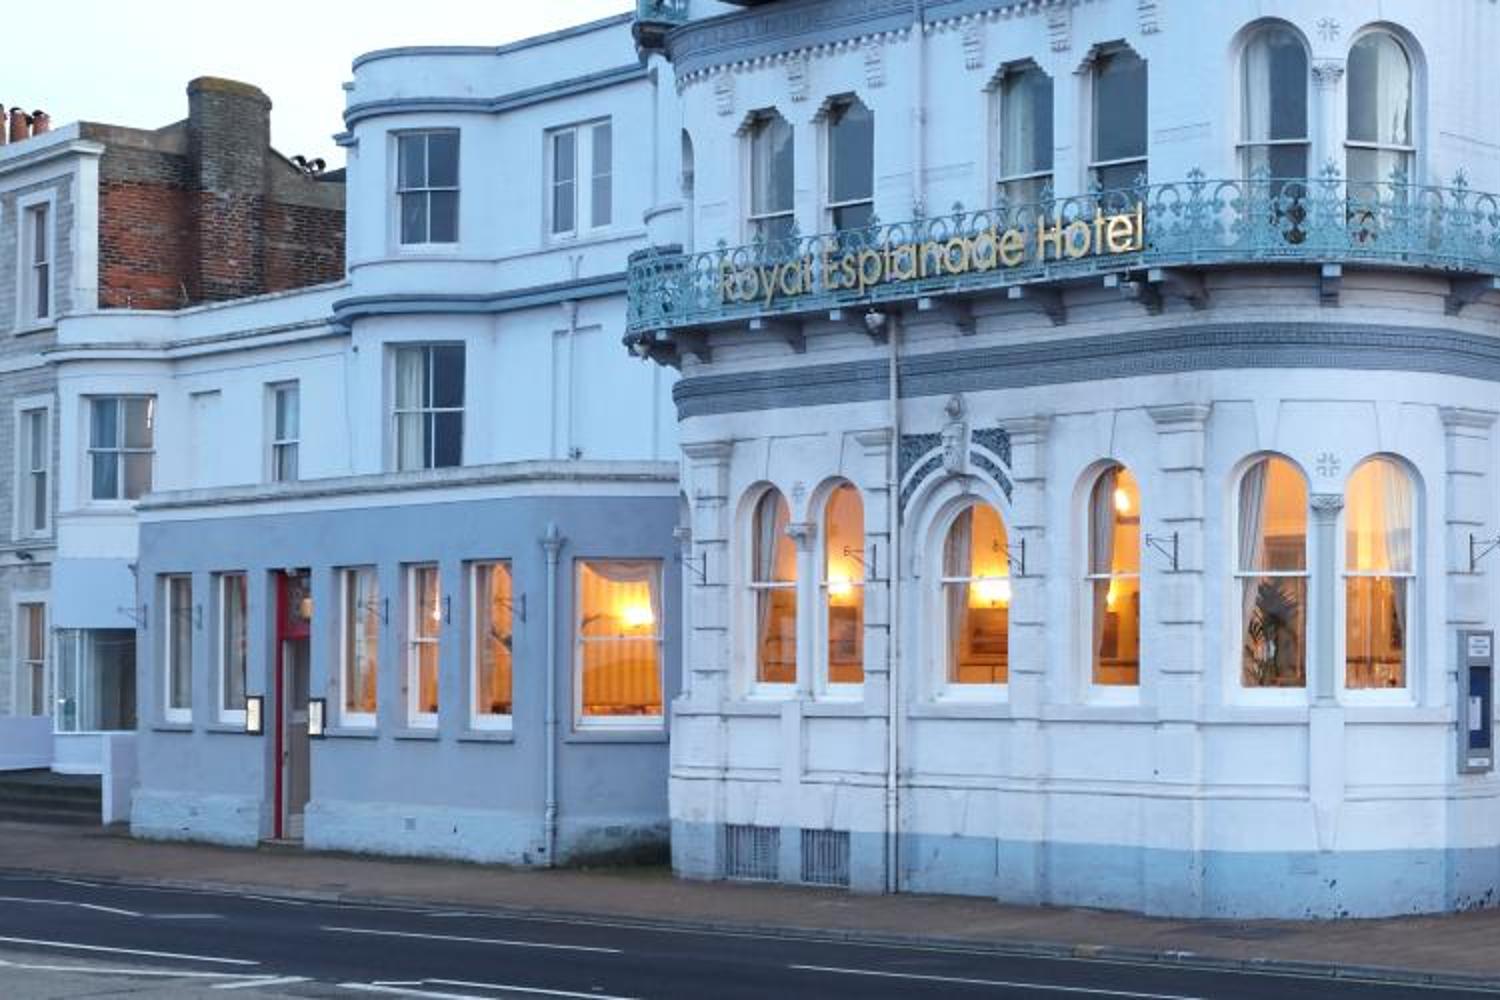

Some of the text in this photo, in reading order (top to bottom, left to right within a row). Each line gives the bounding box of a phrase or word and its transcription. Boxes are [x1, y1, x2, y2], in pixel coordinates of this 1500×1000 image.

[720, 201, 1143, 309] Royal Esplanade Hotel
